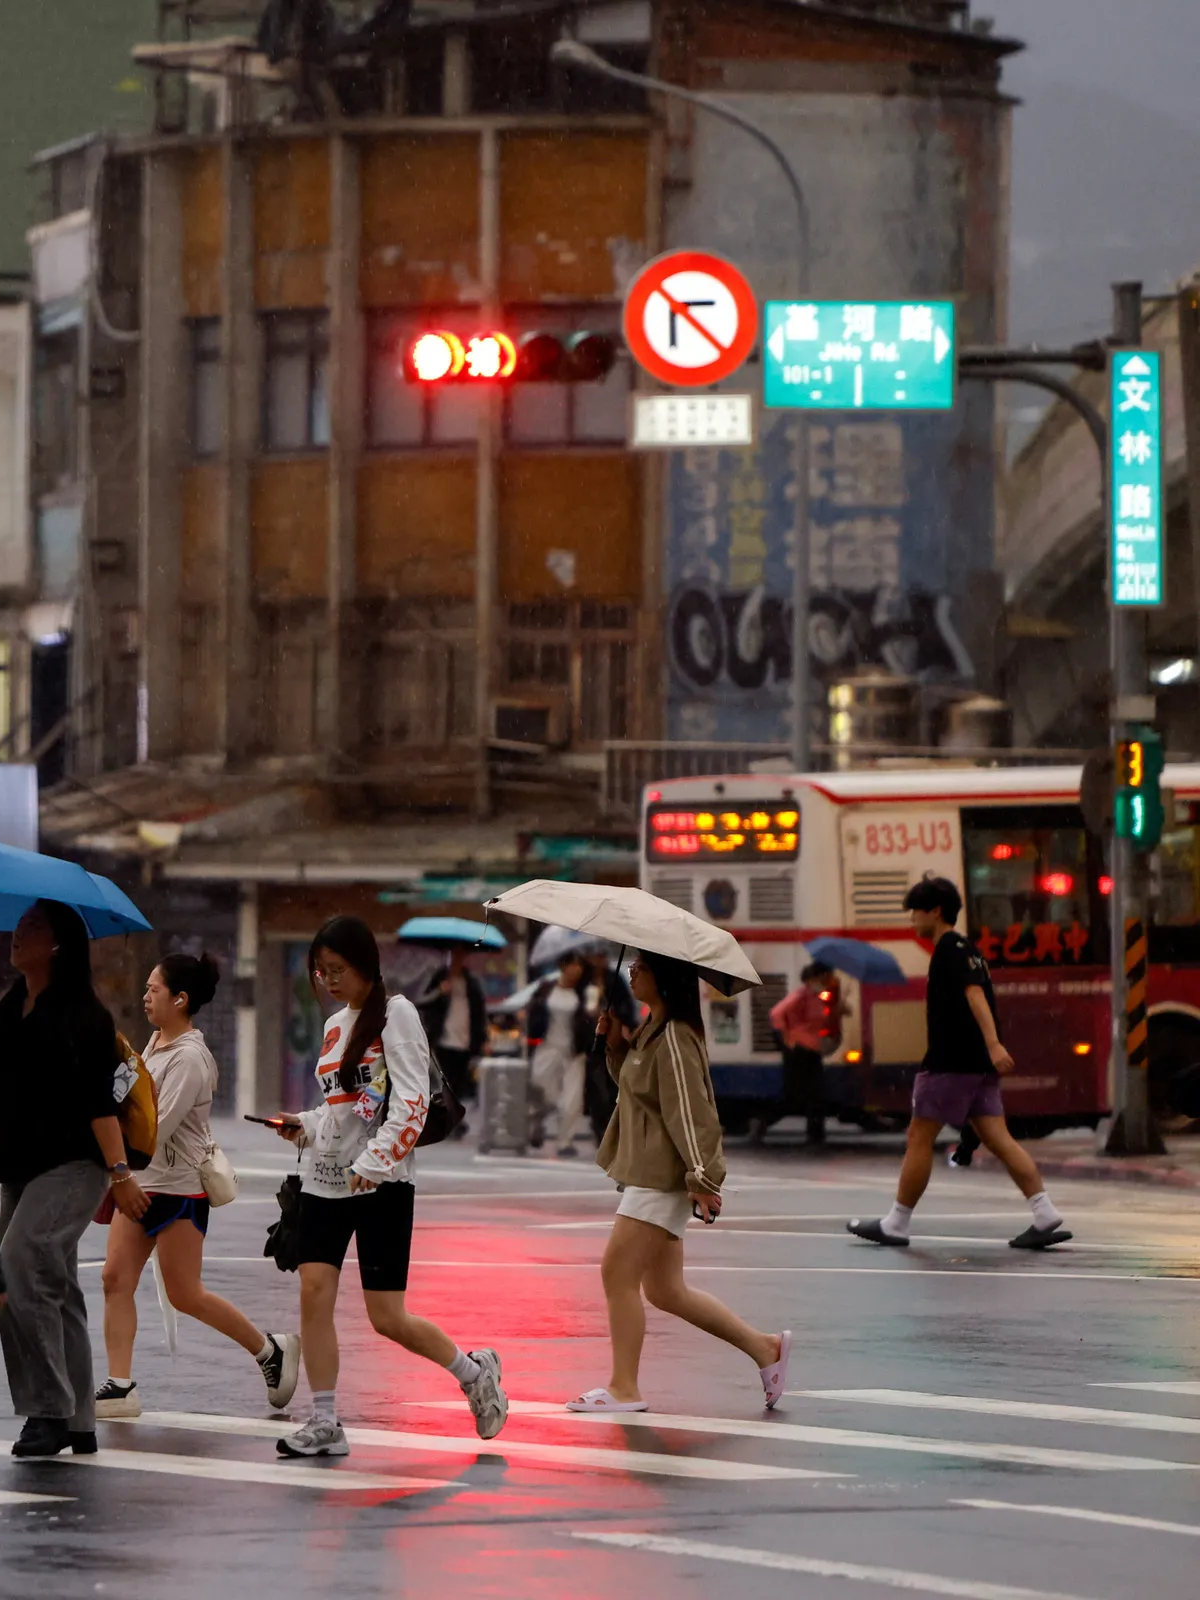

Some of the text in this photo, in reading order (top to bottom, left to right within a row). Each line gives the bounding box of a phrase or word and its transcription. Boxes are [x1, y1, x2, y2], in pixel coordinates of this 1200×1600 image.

[1118, 376, 1152, 519] 文林路
[865, 820, 953, 856] 833-U3
